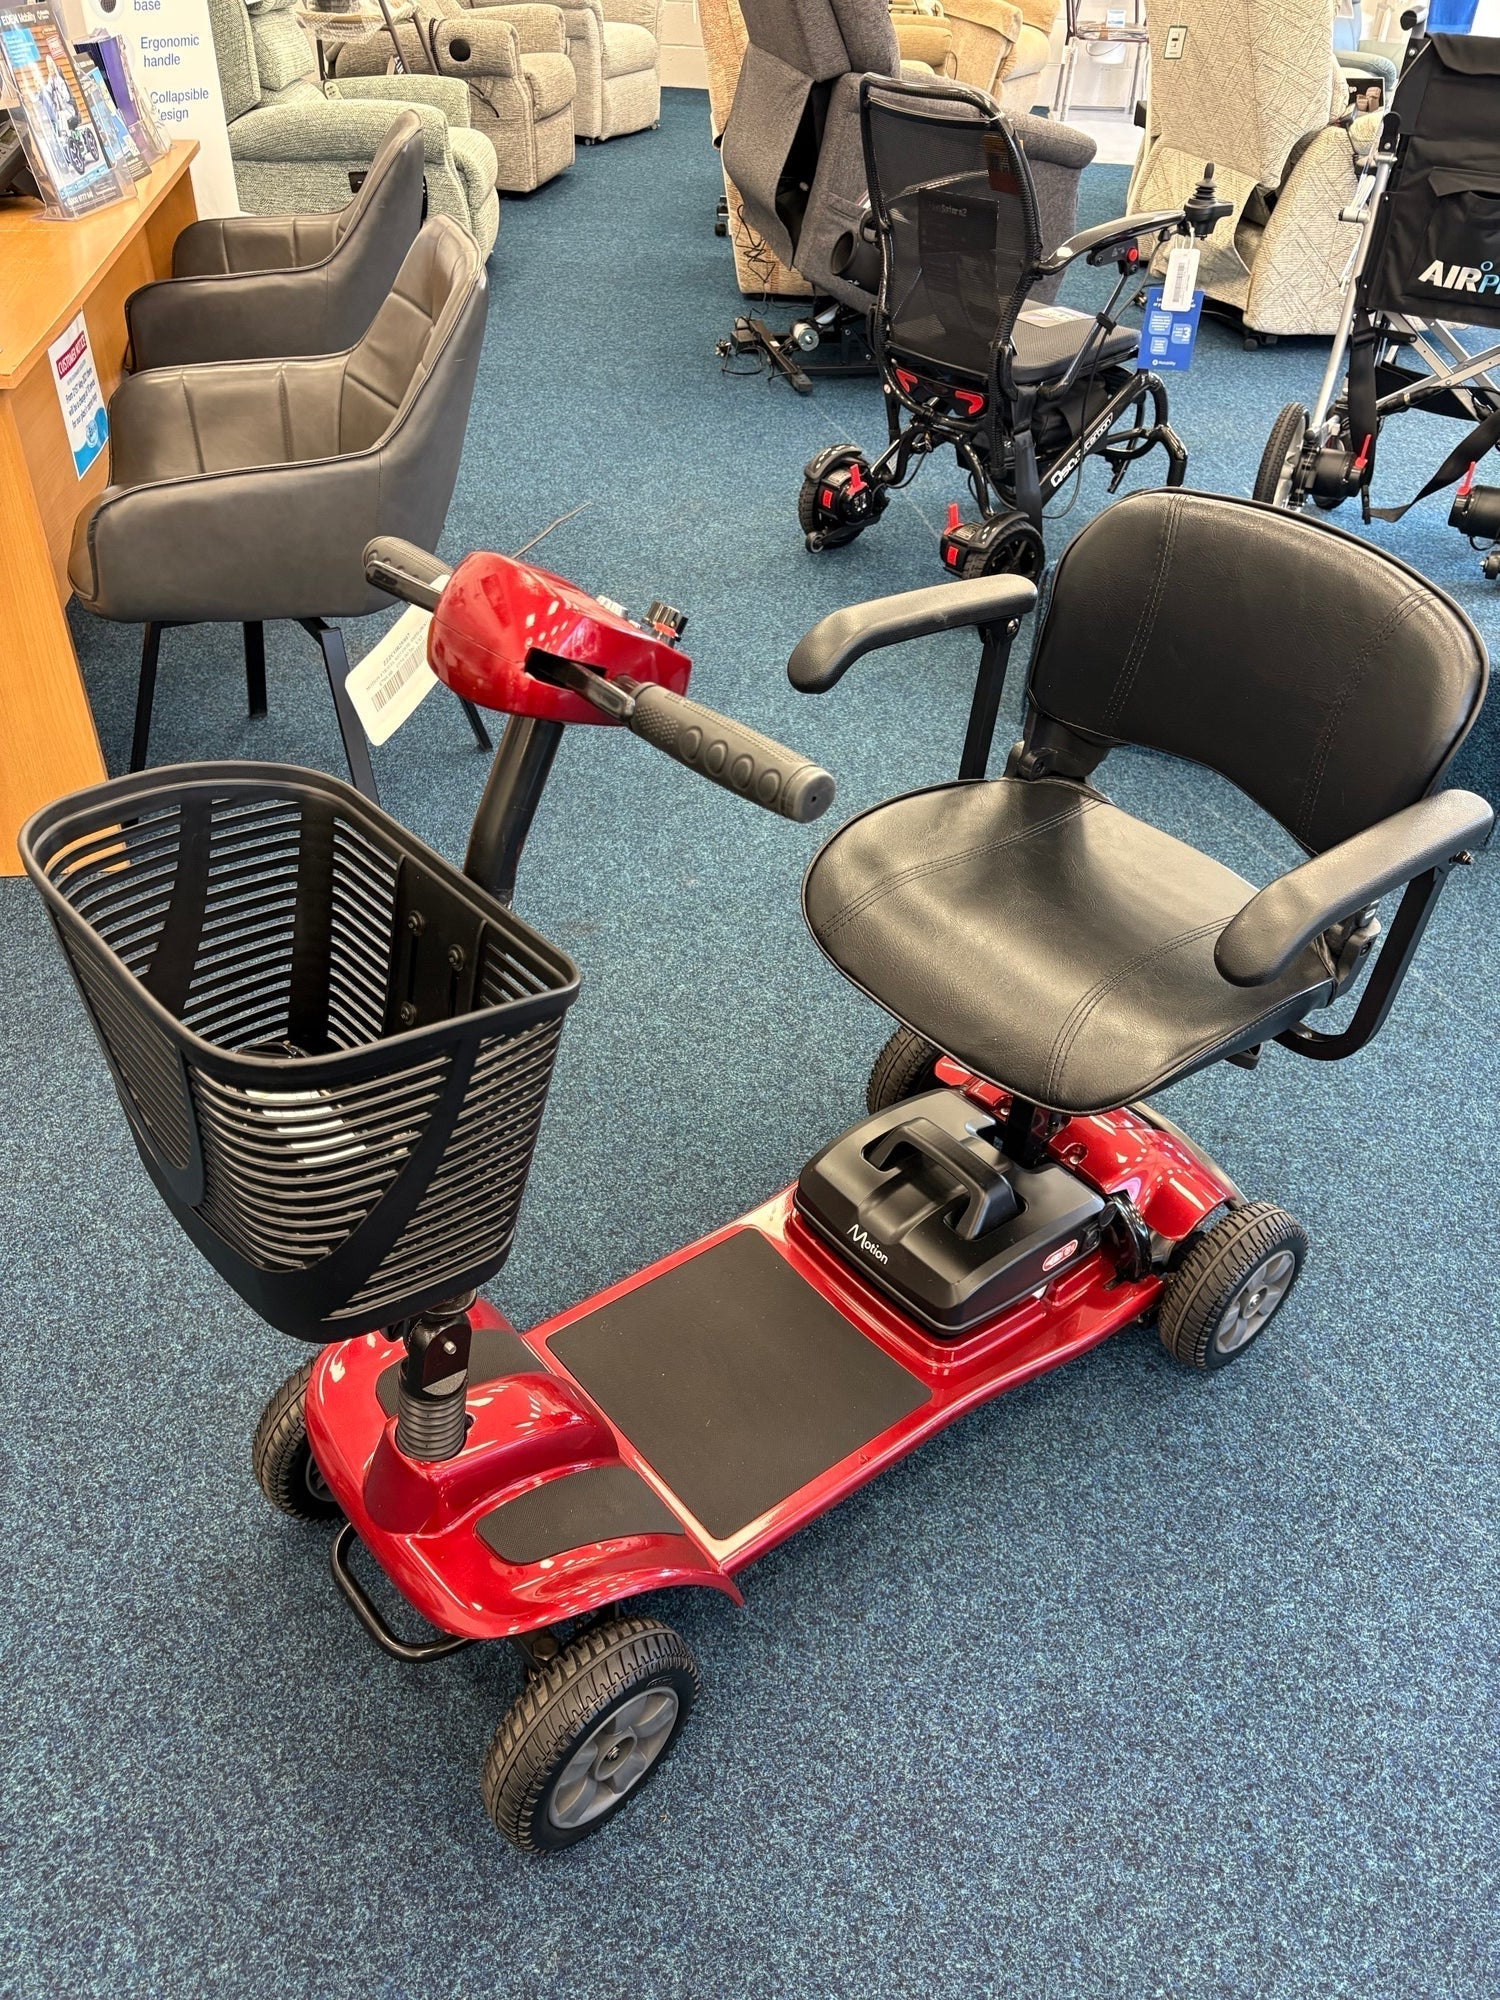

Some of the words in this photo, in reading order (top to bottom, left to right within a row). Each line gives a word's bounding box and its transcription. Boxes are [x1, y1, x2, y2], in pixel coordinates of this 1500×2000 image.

[134, 0, 161, 11] base
[140, 34, 200, 51] Ergonomic
[143, 53, 181, 68] handle
[150, 88, 209, 105] Collapsible
[846, 1223, 889, 1265] Motion
